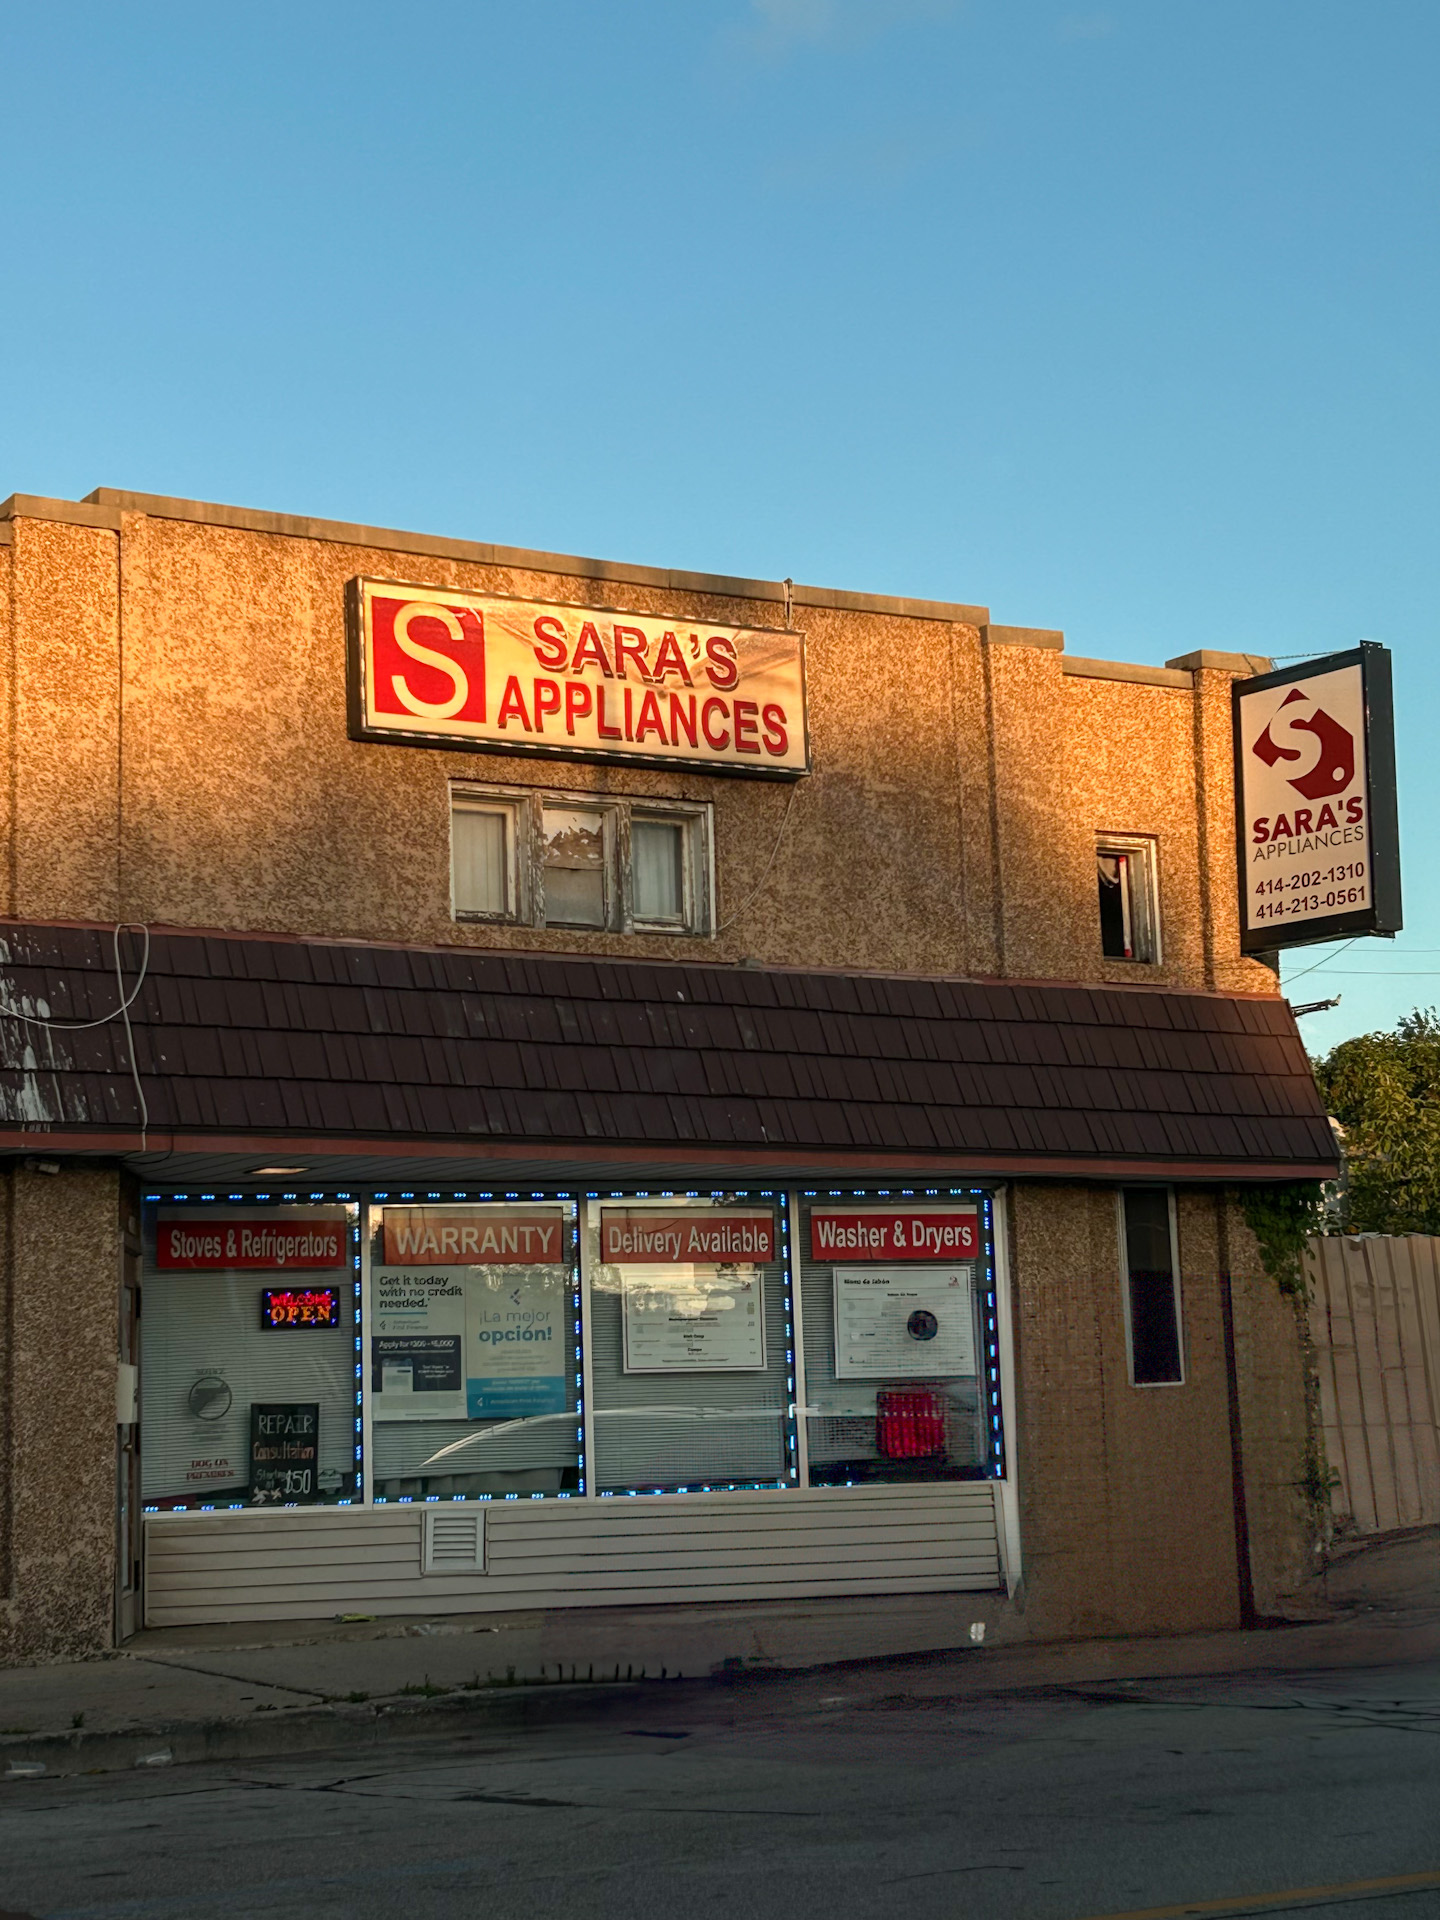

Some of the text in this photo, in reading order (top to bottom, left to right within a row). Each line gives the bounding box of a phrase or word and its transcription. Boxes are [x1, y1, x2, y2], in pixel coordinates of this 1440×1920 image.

[391, 601, 469, 719] S
[533, 615, 739, 692] SARA'S
[497, 675, 788, 756] APPLIANCES
[1252, 796, 1363, 844] SARA'S
[1252, 825, 1364, 862] APPLIANCES
[1255, 861, 1365, 896] 414-202-1310
[1256, 885, 1366, 919] 414-213-0561
[170, 1229, 338, 1264] Stoves & Refrigerators
[396, 1226, 555, 1255] WARRANTY
[608, 1225, 769, 1260] Delivery Available
[817, 1220, 972, 1254] Washer & Dryers
[379, 1275, 449, 1288] Get it today
[379, 1286, 463, 1297] with no credit
[270, 1306, 331, 1323] OPEN
[506, 1310, 551, 1328] mejor
[479, 1326, 553, 1346] opción!
[258, 1414, 314, 1434] REPAIR
[253, 1441, 315, 1461] Consultation
